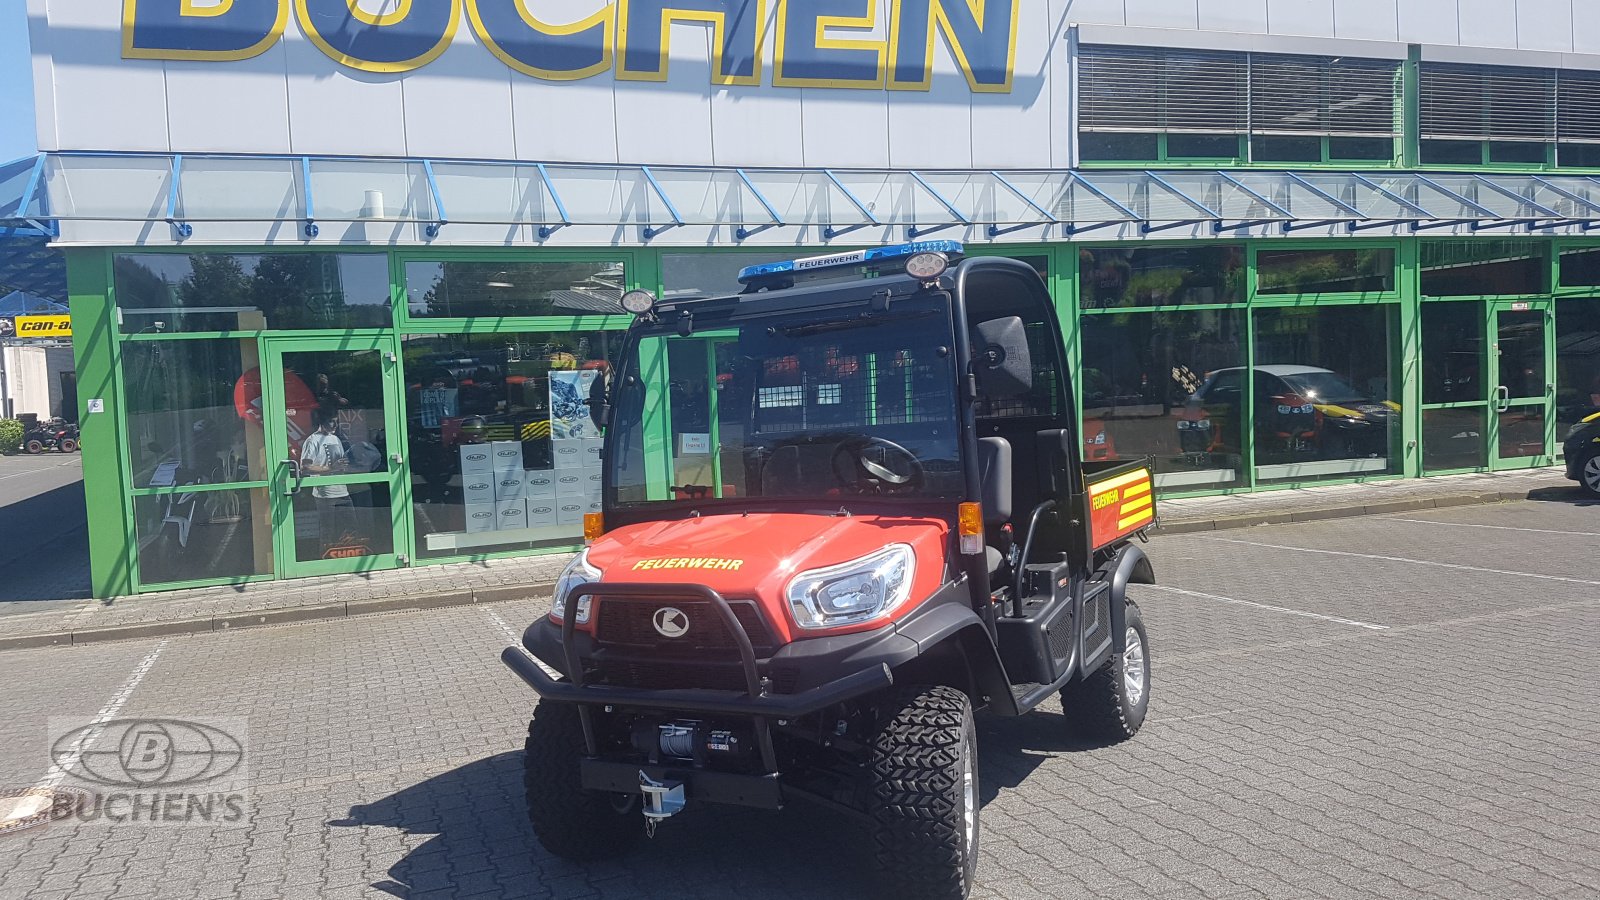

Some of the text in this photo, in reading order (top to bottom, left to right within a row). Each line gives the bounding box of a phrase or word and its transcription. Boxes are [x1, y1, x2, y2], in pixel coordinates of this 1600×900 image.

[799, 254, 860, 269] FEUERWEHR
[21, 321, 72, 331] can-a
[1092, 489, 1120, 511] FEUERWEHR
[631, 557, 744, 571] FEUERWEHR
